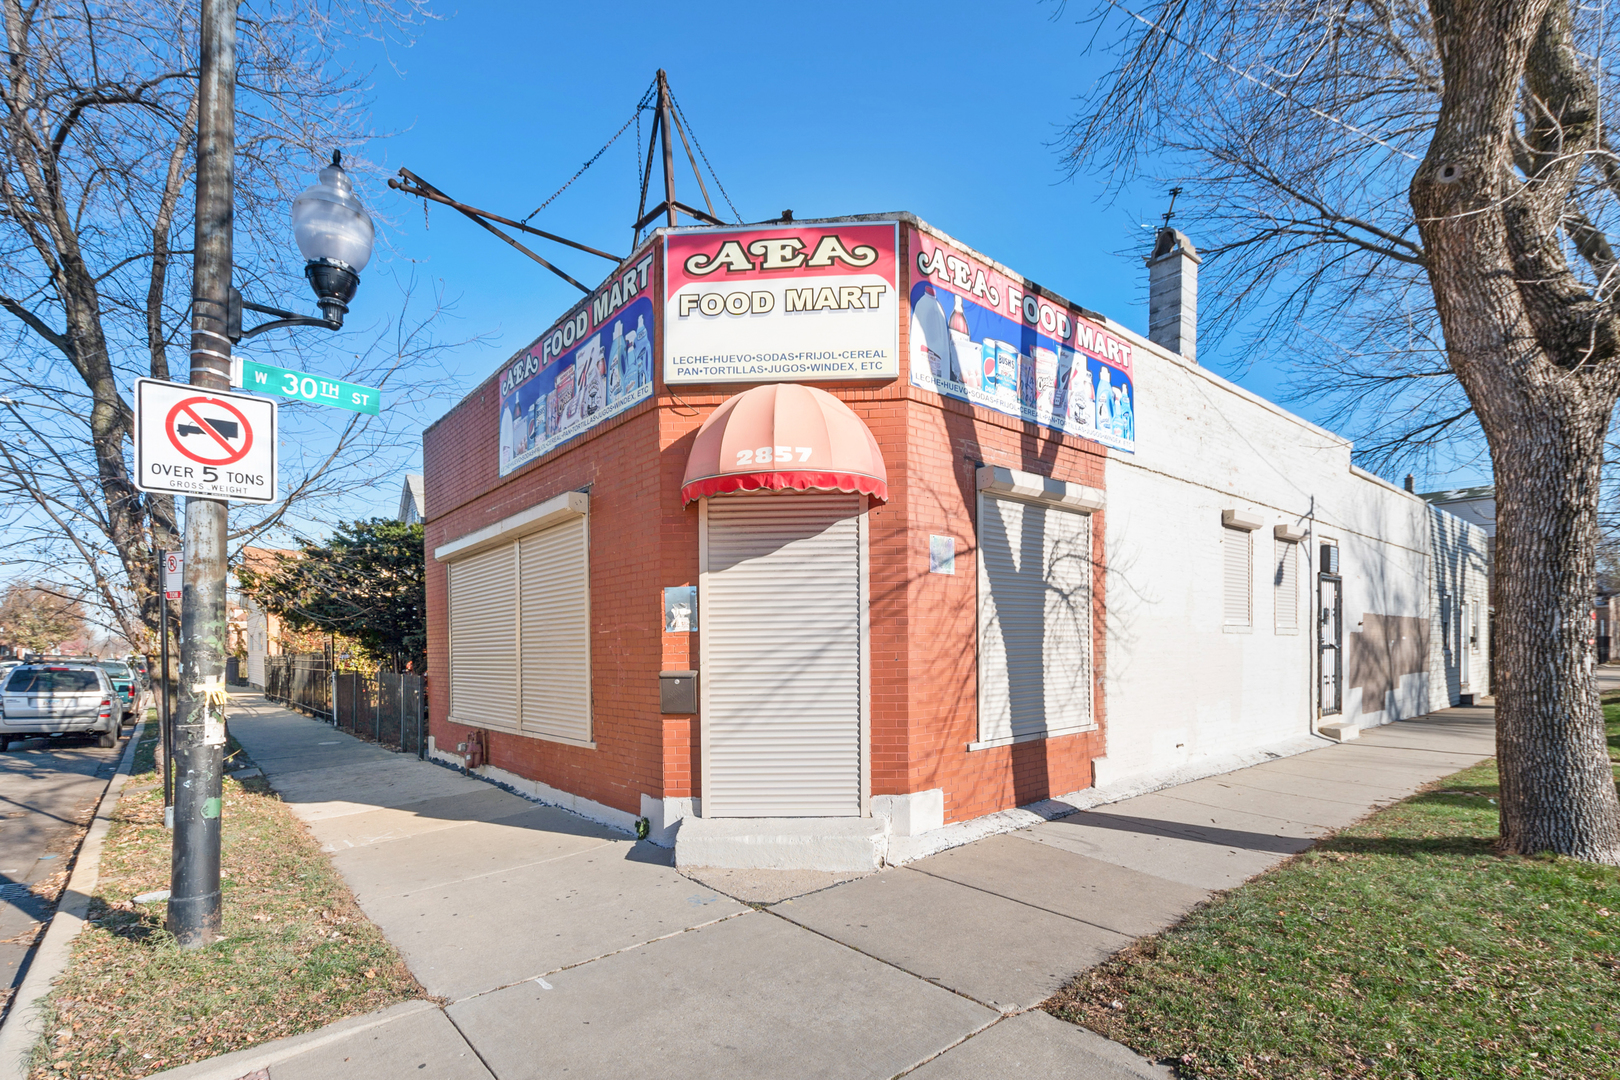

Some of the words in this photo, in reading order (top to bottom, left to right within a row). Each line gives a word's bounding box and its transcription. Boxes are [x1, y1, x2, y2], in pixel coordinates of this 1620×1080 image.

[684, 235, 879, 276] AEA
[679, 291, 775, 316] FOOD
[785, 285, 886, 312] MART
[917, 247, 1000, 307] AEA
[1008, 285, 1072, 341] FOOD
[1075, 321, 1131, 368] MART
[501, 352, 539, 397] AEA
[542, 309, 588, 366] FOOD
[592, 252, 653, 327] MART
[861, 361, 883, 371] ETC
[254, 370, 268, 385] W
[281, 373, 339, 400] 30TH
[351, 392, 370, 407] ST
[736, 445, 813, 466] 2857
[151, 463, 194, 479] OVER
[202, 467, 219, 483] 5
[226, 471, 264, 486] TONS
[169, 480, 204, 490] GROSS
[210, 484, 248, 495] WEIGHT
